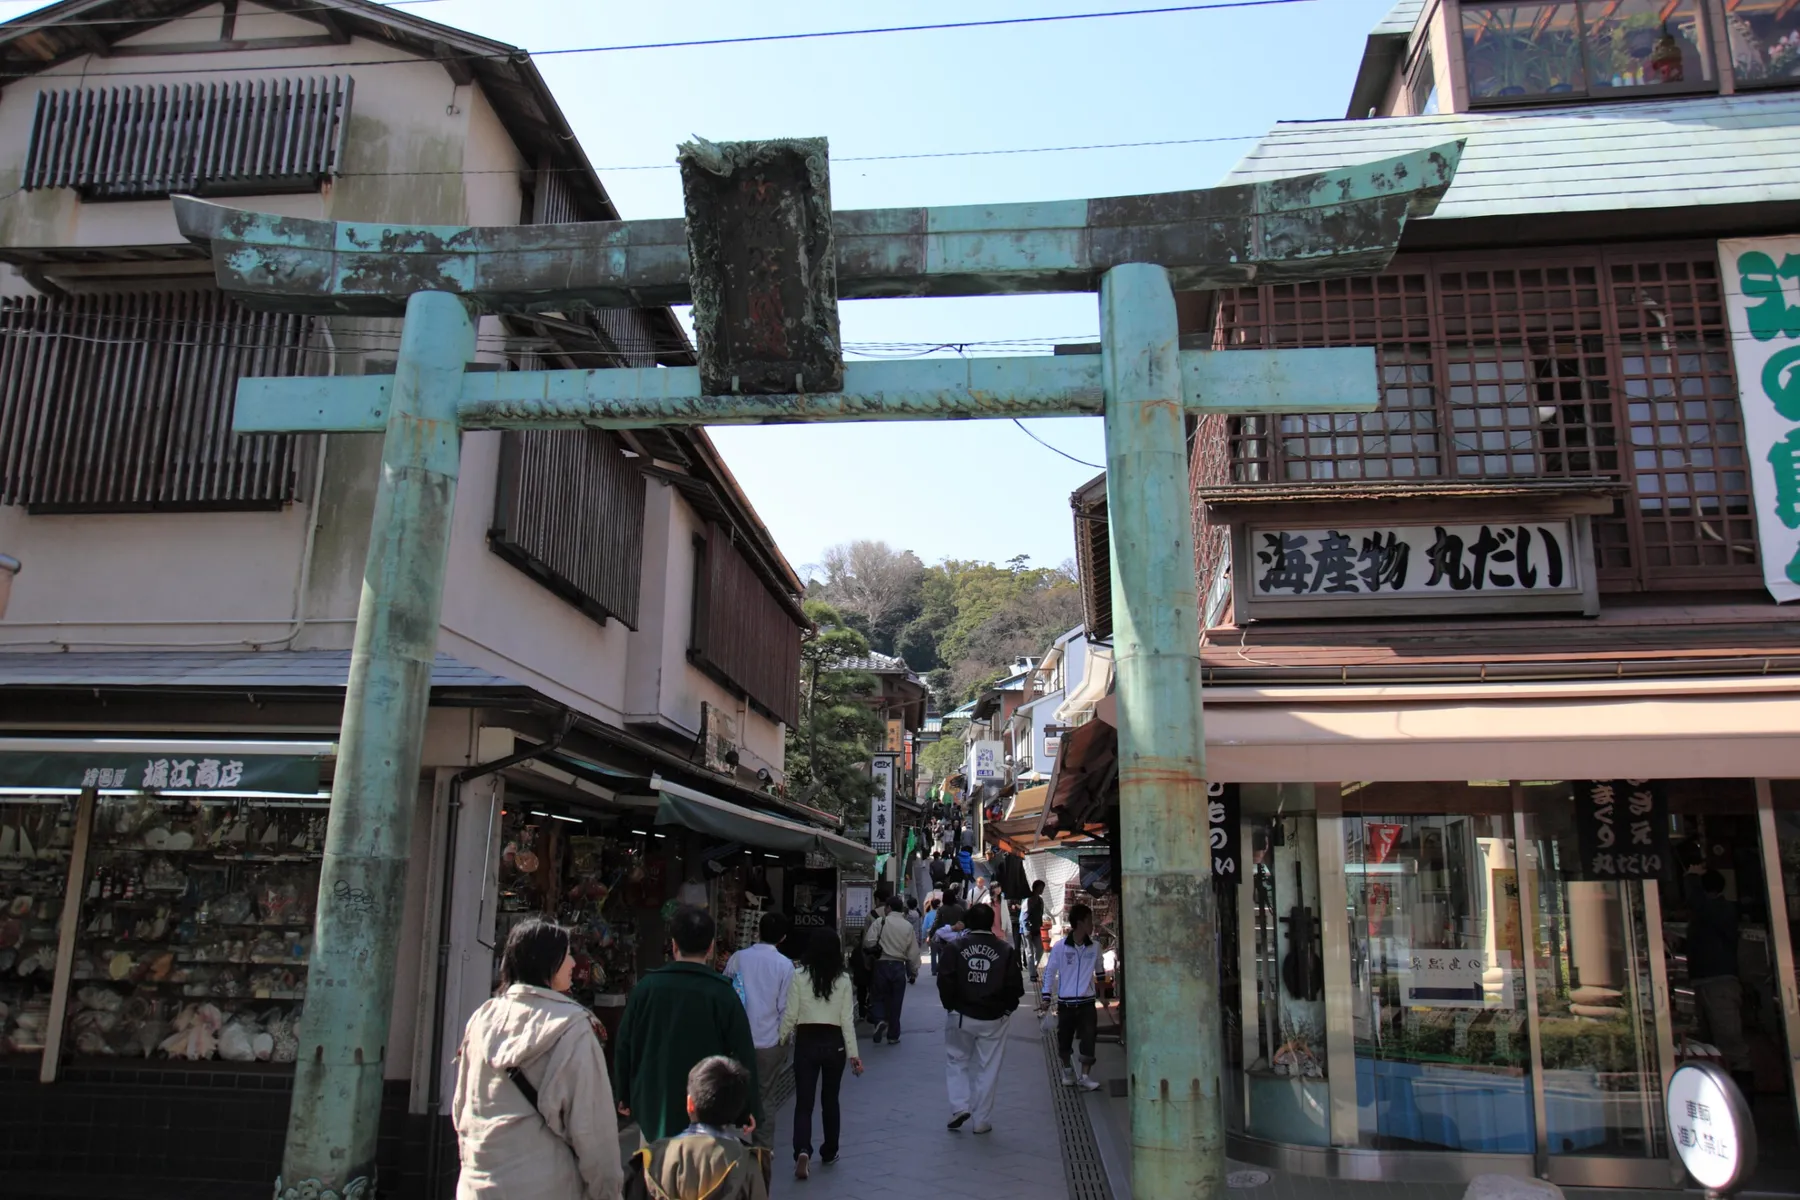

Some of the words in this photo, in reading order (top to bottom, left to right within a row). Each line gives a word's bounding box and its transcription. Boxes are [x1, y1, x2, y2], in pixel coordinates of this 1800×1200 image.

[1257, 530, 1410, 594] 海産物
[1425, 525, 1563, 590] 丸だい
[142, 758, 244, 788] 堀江商店
[1591, 779, 1615, 848] まぐり
[1592, 853, 1661, 874] 丸だい
[795, 914, 825, 926] BOSS
[960, 944, 1000, 961] PRINCETON
[967, 971, 988, 983] CREW
[1685, 1100, 1712, 1125] 車両
[1677, 1124, 1729, 1160] 進入禁止
